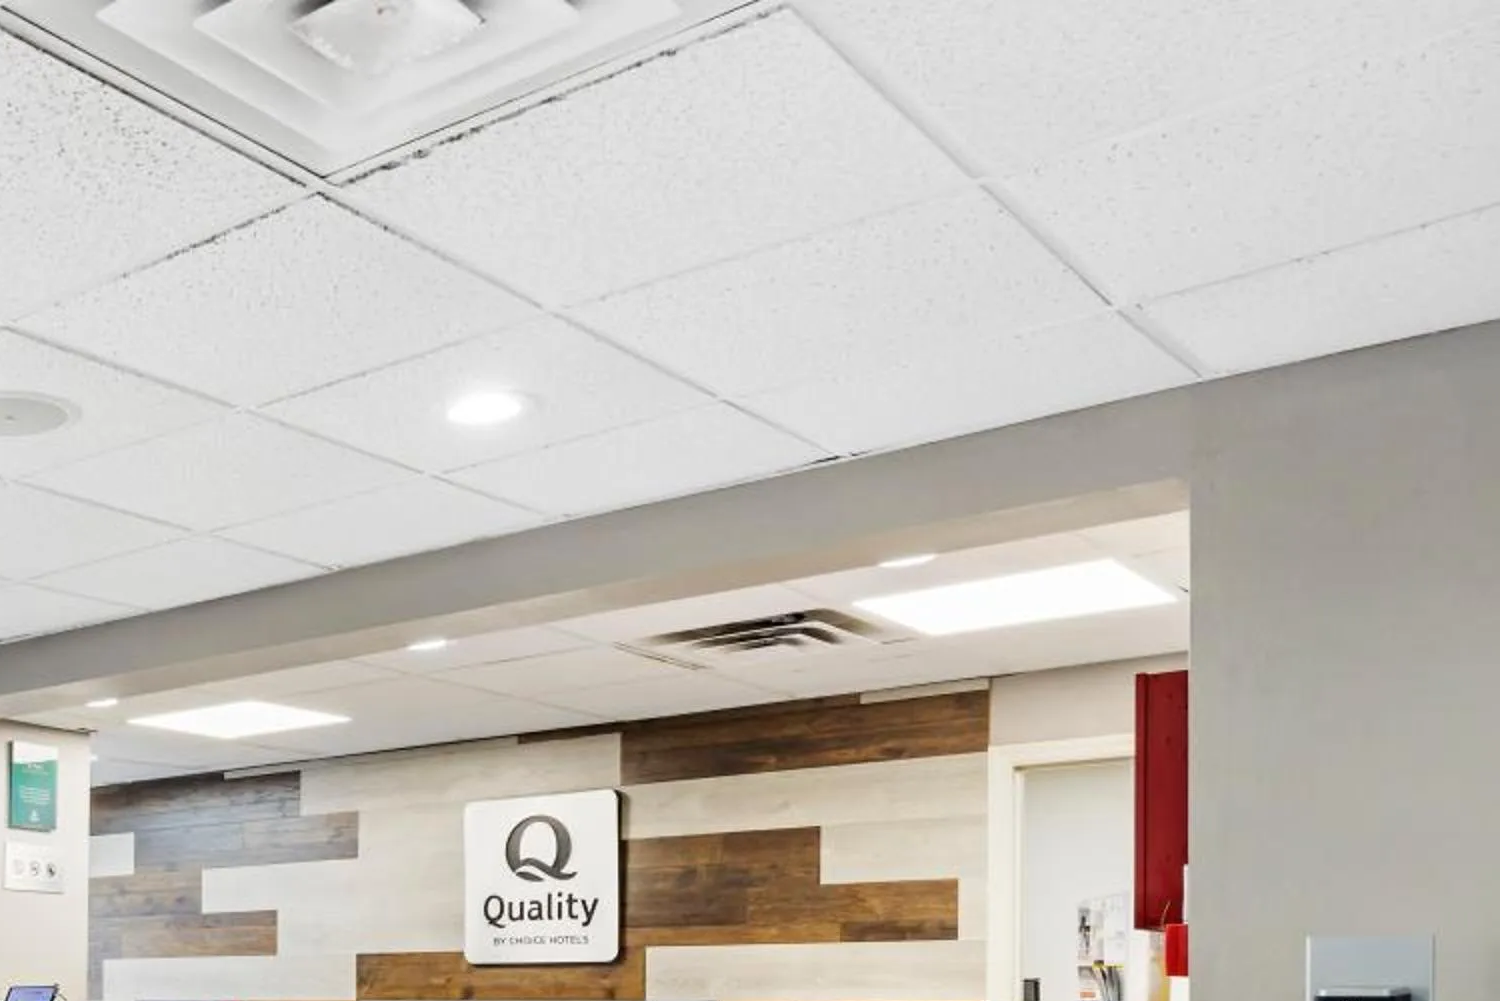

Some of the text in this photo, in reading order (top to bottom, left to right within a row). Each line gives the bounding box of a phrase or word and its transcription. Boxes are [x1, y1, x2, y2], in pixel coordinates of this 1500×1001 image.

[483, 892, 599, 929] Quality
[493, 935, 589, 946] BY CHOICE HOTELS
